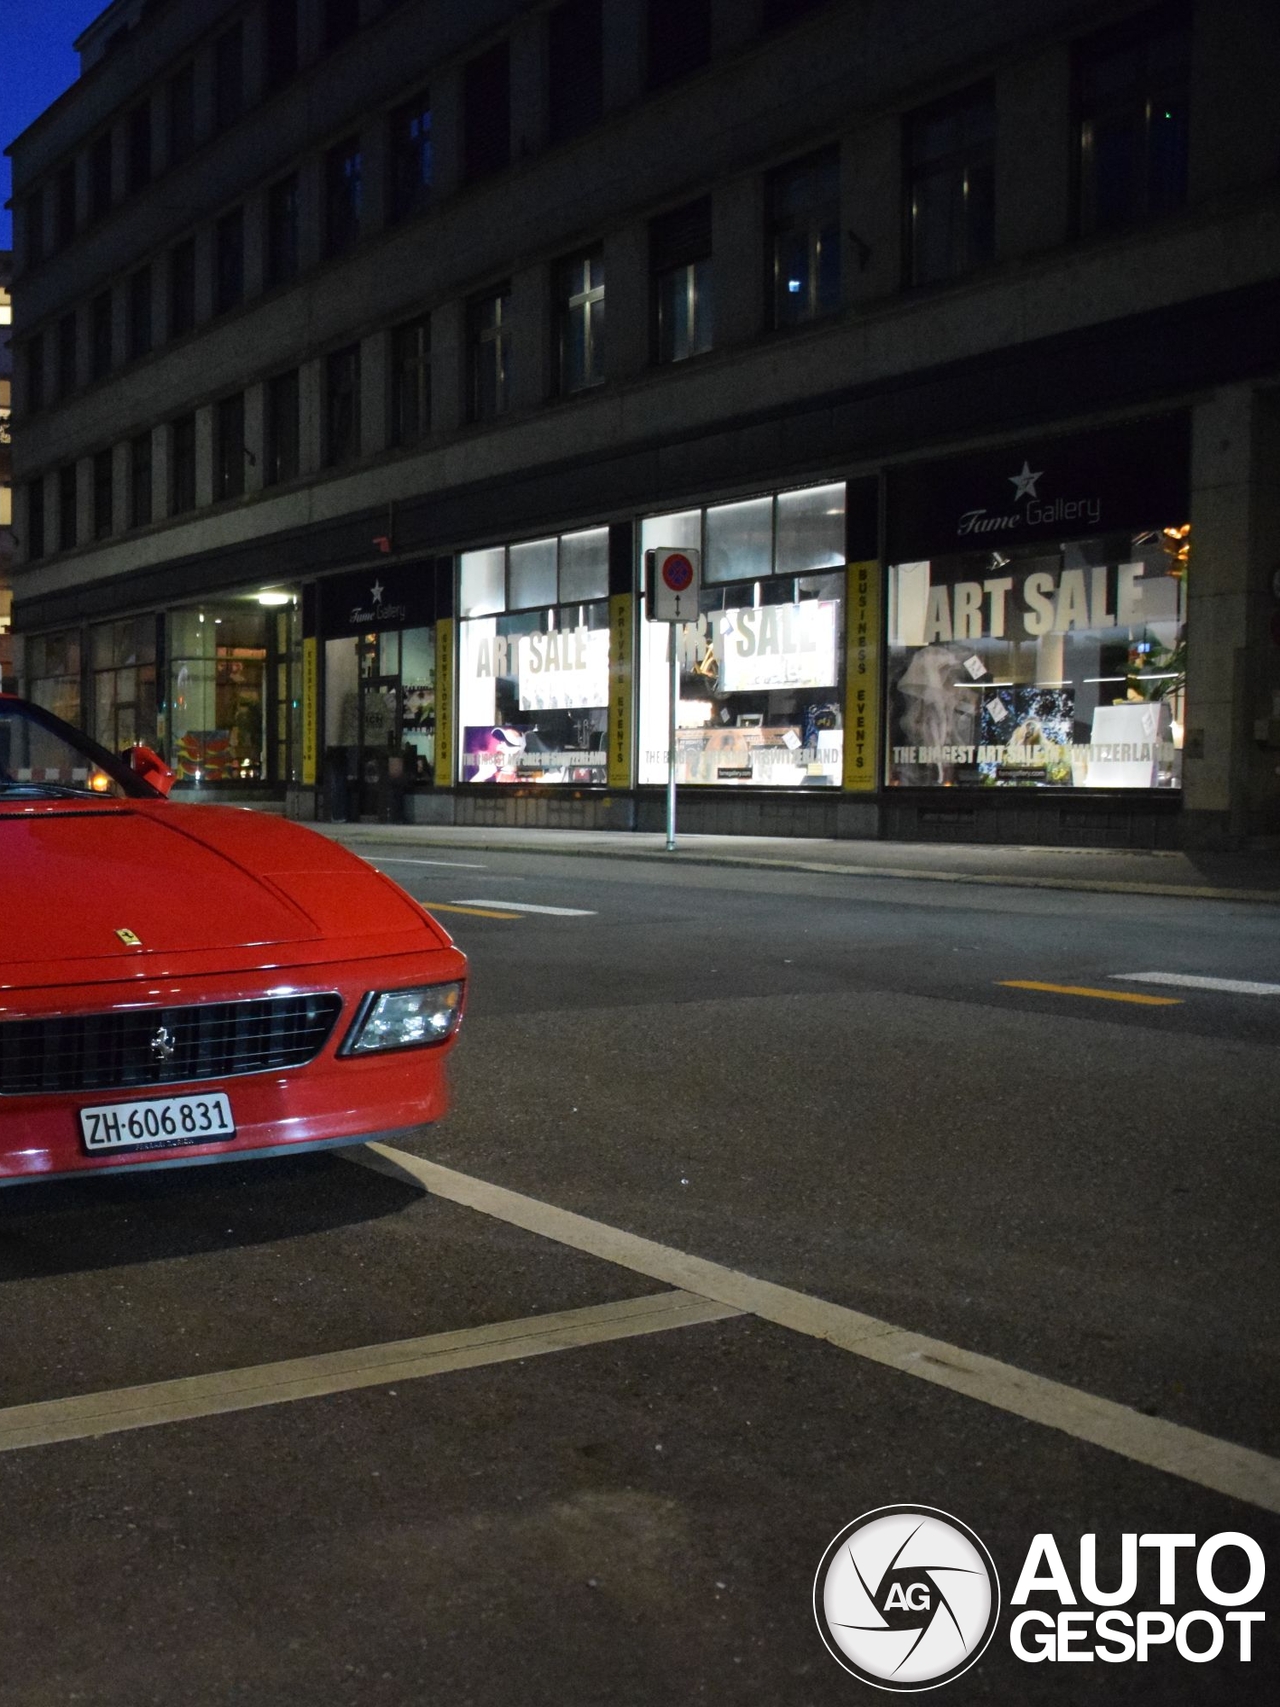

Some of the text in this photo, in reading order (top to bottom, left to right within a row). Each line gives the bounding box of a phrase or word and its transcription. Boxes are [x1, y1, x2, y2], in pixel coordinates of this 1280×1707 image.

[957, 498, 1100, 536] Fame Gallery
[349, 604, 405, 624] Fame Gallery
[736, 600, 818, 658] SALE
[923, 562, 1145, 643] ART SALE
[476, 625, 588, 678] ART SALE
[856, 569, 867, 768] BUSINESS EVENTS
[616, 606, 625, 763] PRIVATE EVENTS
[645, 751, 660, 763] THE
[893, 746, 916, 763] THE
